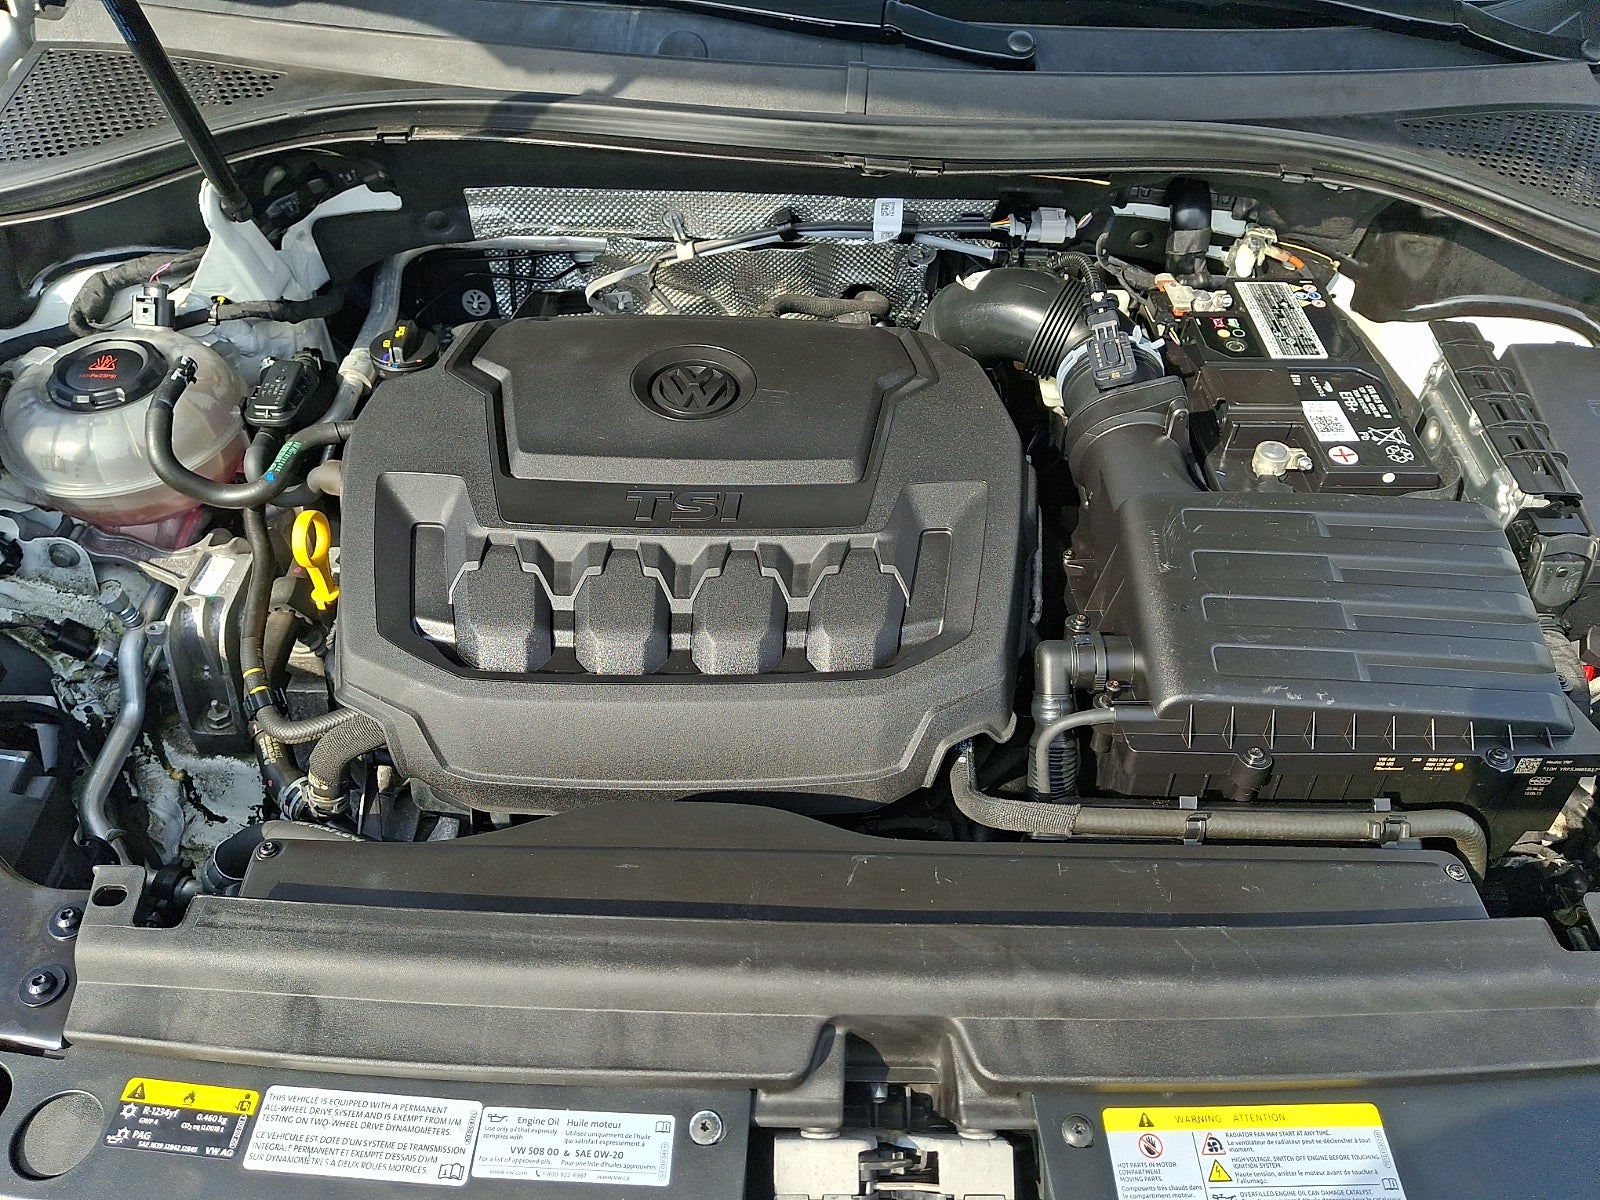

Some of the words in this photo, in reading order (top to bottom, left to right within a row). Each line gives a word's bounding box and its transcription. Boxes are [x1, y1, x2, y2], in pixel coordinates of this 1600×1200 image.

[1310, 376, 1326, 397] CLARIOS
[1339, 392, 1358, 412] EFB+
[626, 490, 744, 522] TSI
[269, 1093, 286, 1101] THIS
[288, 1094, 319, 1104] VEHICLE
[329, 1098, 368, 1108] EQUIPPED
[370, 1101, 391, 1109] WITH
[400, 1104, 448, 1114] PERMANENT
[142, 1106, 180, 1119] R-1234yf
[264, 1104, 307, 1114] ALL-WHEEL
[309, 1107, 331, 1116] DRIVE
[334, 1109, 363, 1118] SYSTEM
[364, 1111, 382, 1120] AND
[384, 1112, 391, 1120] IS
[393, 1114, 423, 1122] EXEMPT
[425, 1116, 447, 1125] FROM
[1175, 1114, 1222, 1124] WARNING
[1233, 1114, 1285, 1122] ATTENTION
[196, 1114, 218, 1122] 0.460
[219, 1115, 228, 1125] kg
[262, 1114, 294, 1124] TESTING
[295, 1117, 308, 1125] ON
[310, 1117, 359, 1129] TWO-WHEEL
[361, 1122, 384, 1130] DRIVE
[385, 1123, 451, 1136] DYNAMOMETERS.
[518, 1117, 546, 1126] Engine
[548, 1117, 559, 1125] Oil
[567, 1119, 588, 1127] Huile
[591, 1121, 622, 1129] moteur
[132, 1130, 152, 1140] PAG
[255, 1131, 267, 1139] CE
[305, 1135, 318, 1143] EST
[341, 1137, 363, 1147] D'UN
[397, 1142, 408, 1150] DE
[410, 1143, 466, 1155] TRANSMISSION
[205, 1146, 219, 1156] VW
[220, 1148, 234, 1157] AG
[294, 1145, 340, 1156] PERMANENT
[510, 1146, 526, 1154] VW
[529, 1147, 545, 1155] 508
[594, 1151, 624, 1159] 0W-20
[337, 1160, 359, 1169] DEUX
[361, 1162, 387, 1171] ROUES
